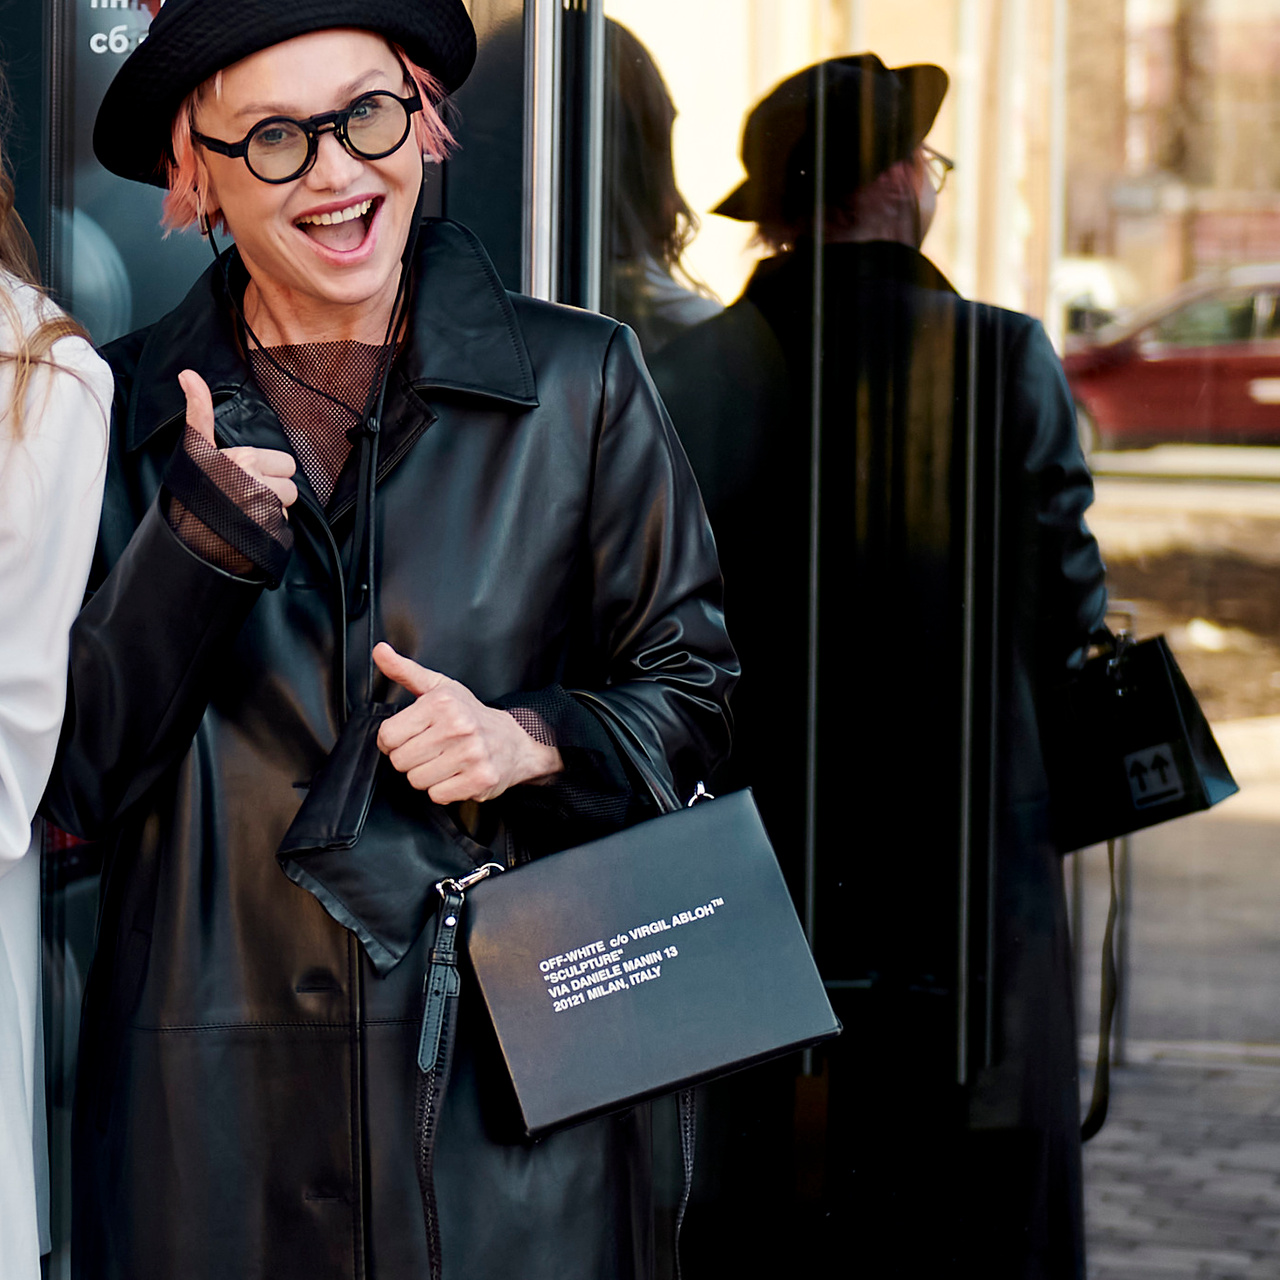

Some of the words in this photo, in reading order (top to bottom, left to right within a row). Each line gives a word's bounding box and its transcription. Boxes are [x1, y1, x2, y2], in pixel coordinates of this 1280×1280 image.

[89, 24, 129, 54] сб
[539, 940, 606, 972] OFF-WHITE
[609, 933, 629, 948] c/o
[628, 919, 671, 940] VIRGIL
[543, 948, 624, 984] "SCULPTURE"
[547, 983, 570, 998] VIA
[570, 964, 623, 991] DANIELE
[622, 950, 663, 973] MANIN
[663, 945, 679, 959] 13
[553, 992, 586, 1013] 20121
[586, 977, 630, 1001] MILAN,
[628, 965, 661, 986] ITALY
